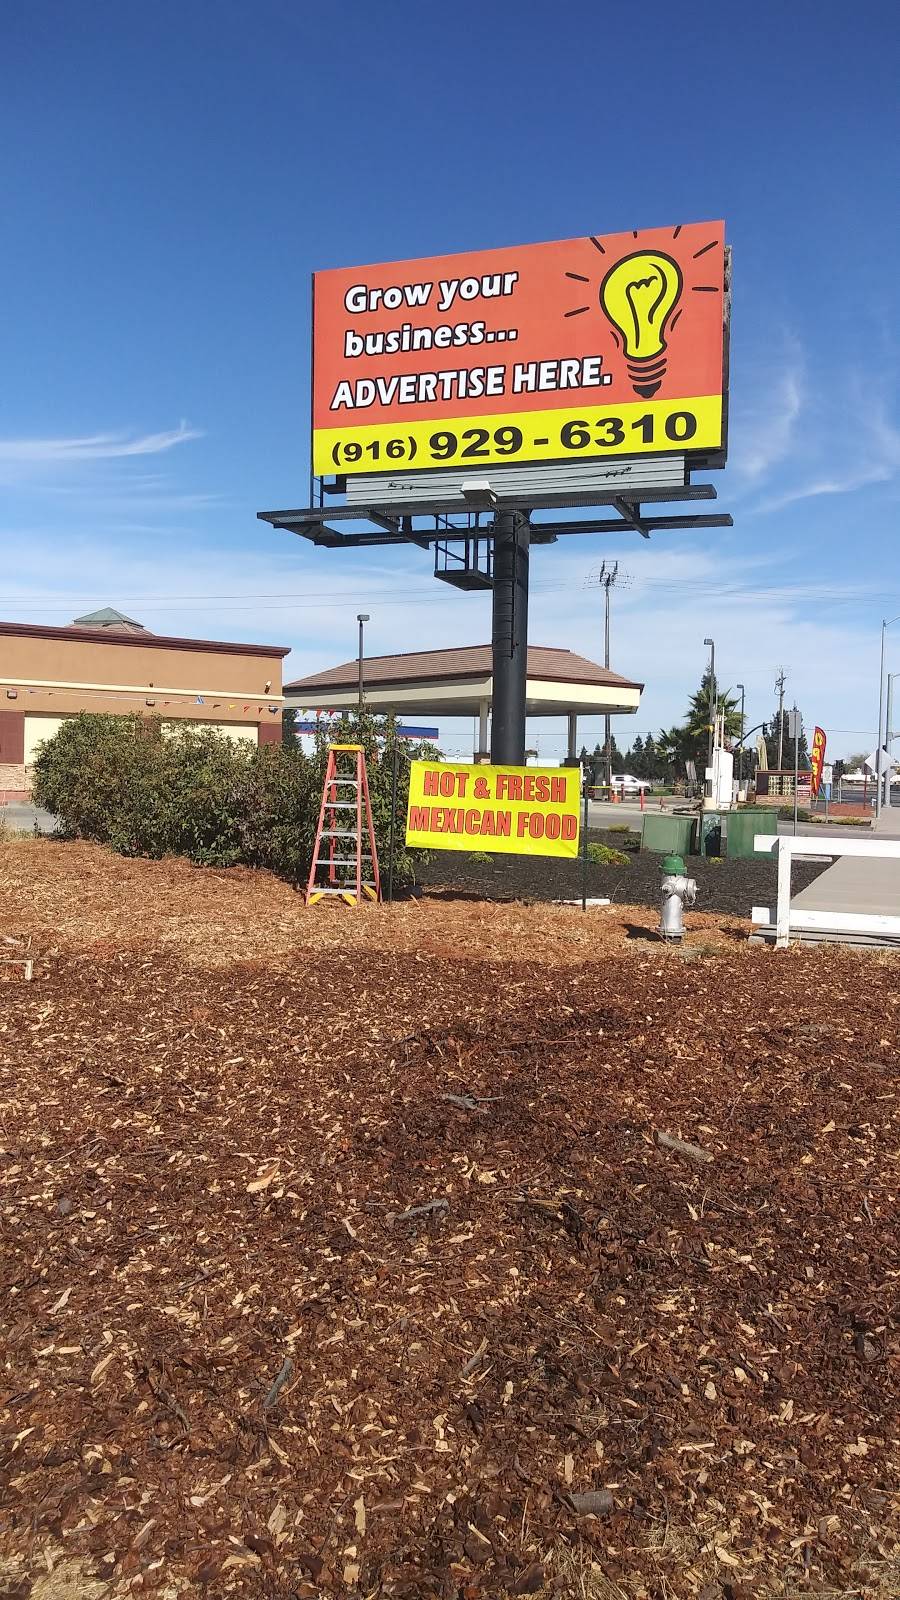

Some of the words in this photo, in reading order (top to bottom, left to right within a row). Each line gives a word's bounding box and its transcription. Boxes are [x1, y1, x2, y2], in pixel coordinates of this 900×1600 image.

[345, 280, 432, 314] Grow
[438, 271, 519, 313] your
[345, 321, 518, 358] business...
[330, 365, 504, 410] ADVERTISE
[512, 356, 613, 394] HERE.
[331, 436, 418, 466] (916)
[429, 425, 524, 460] 929
[560, 411, 698, 450] 6310
[423, 771, 469, 798] HOT
[473, 777, 491, 800] &
[496, 774, 567, 803] FRESH
[409, 806, 512, 837] MEXICAN
[517, 812, 577, 841] FOOD
